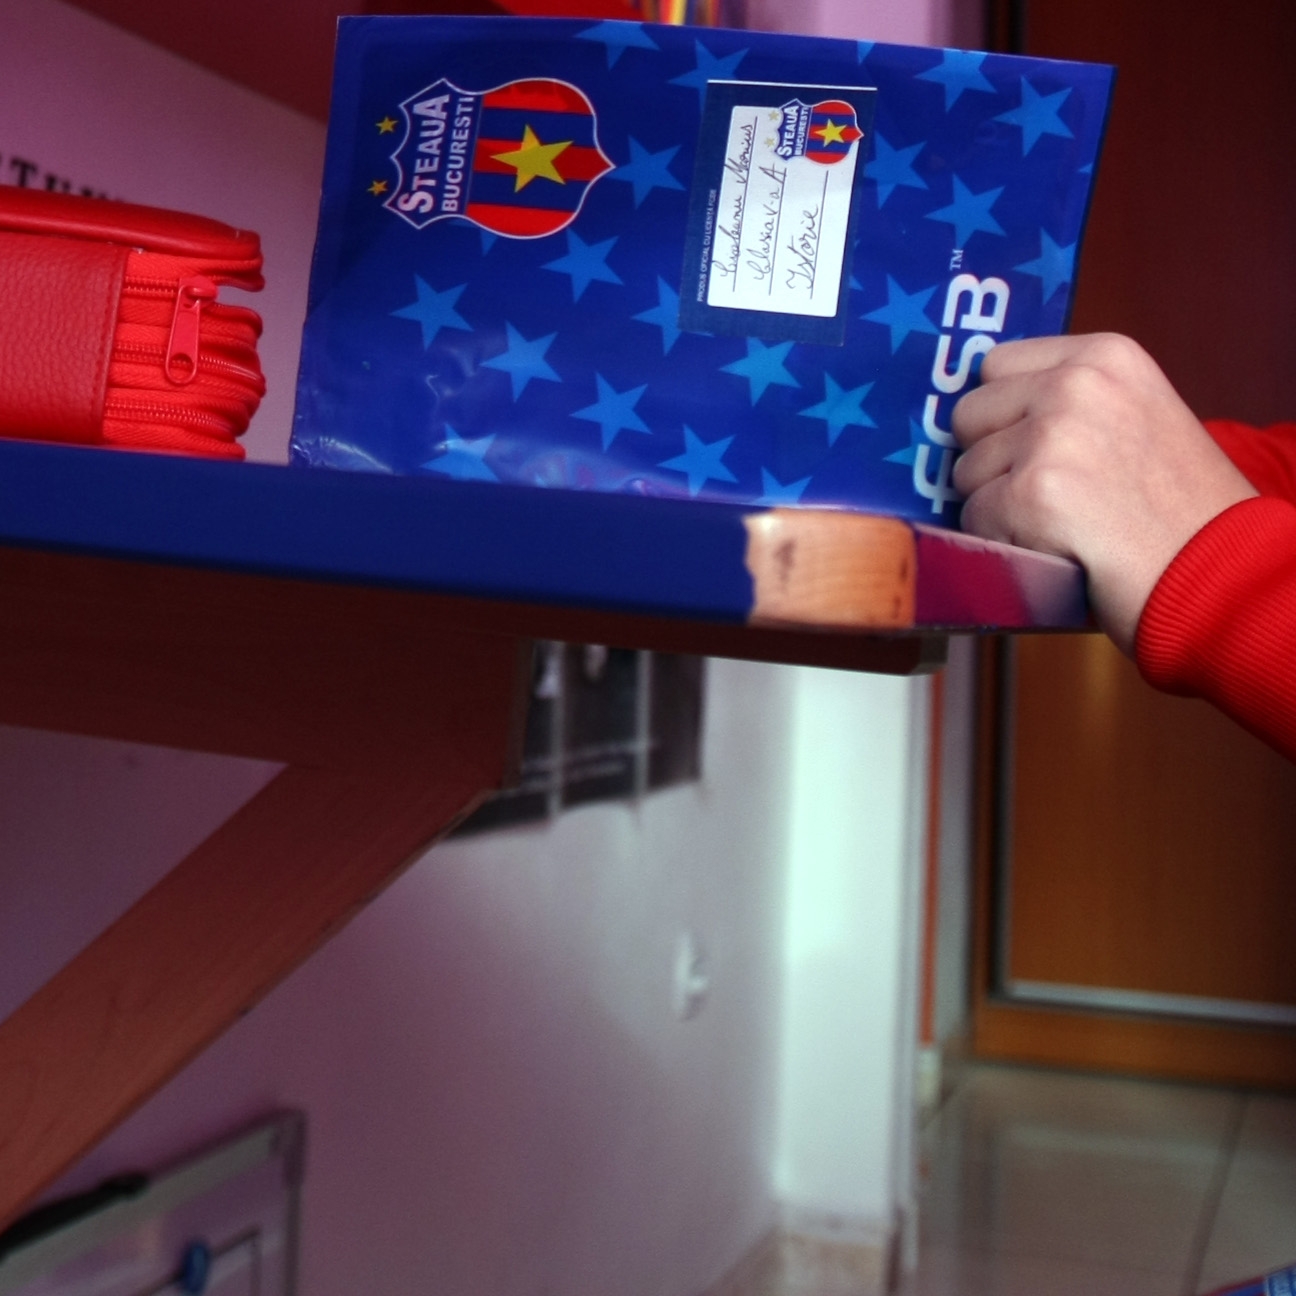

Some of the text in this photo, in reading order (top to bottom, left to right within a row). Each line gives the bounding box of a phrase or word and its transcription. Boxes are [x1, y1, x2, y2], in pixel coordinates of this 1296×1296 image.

[396, 93, 451, 214] STEAUA
[441, 95, 475, 212] BUCURESTI
[777, 105, 800, 157] STEAUA
[696, 273, 707, 302] PRODUS
